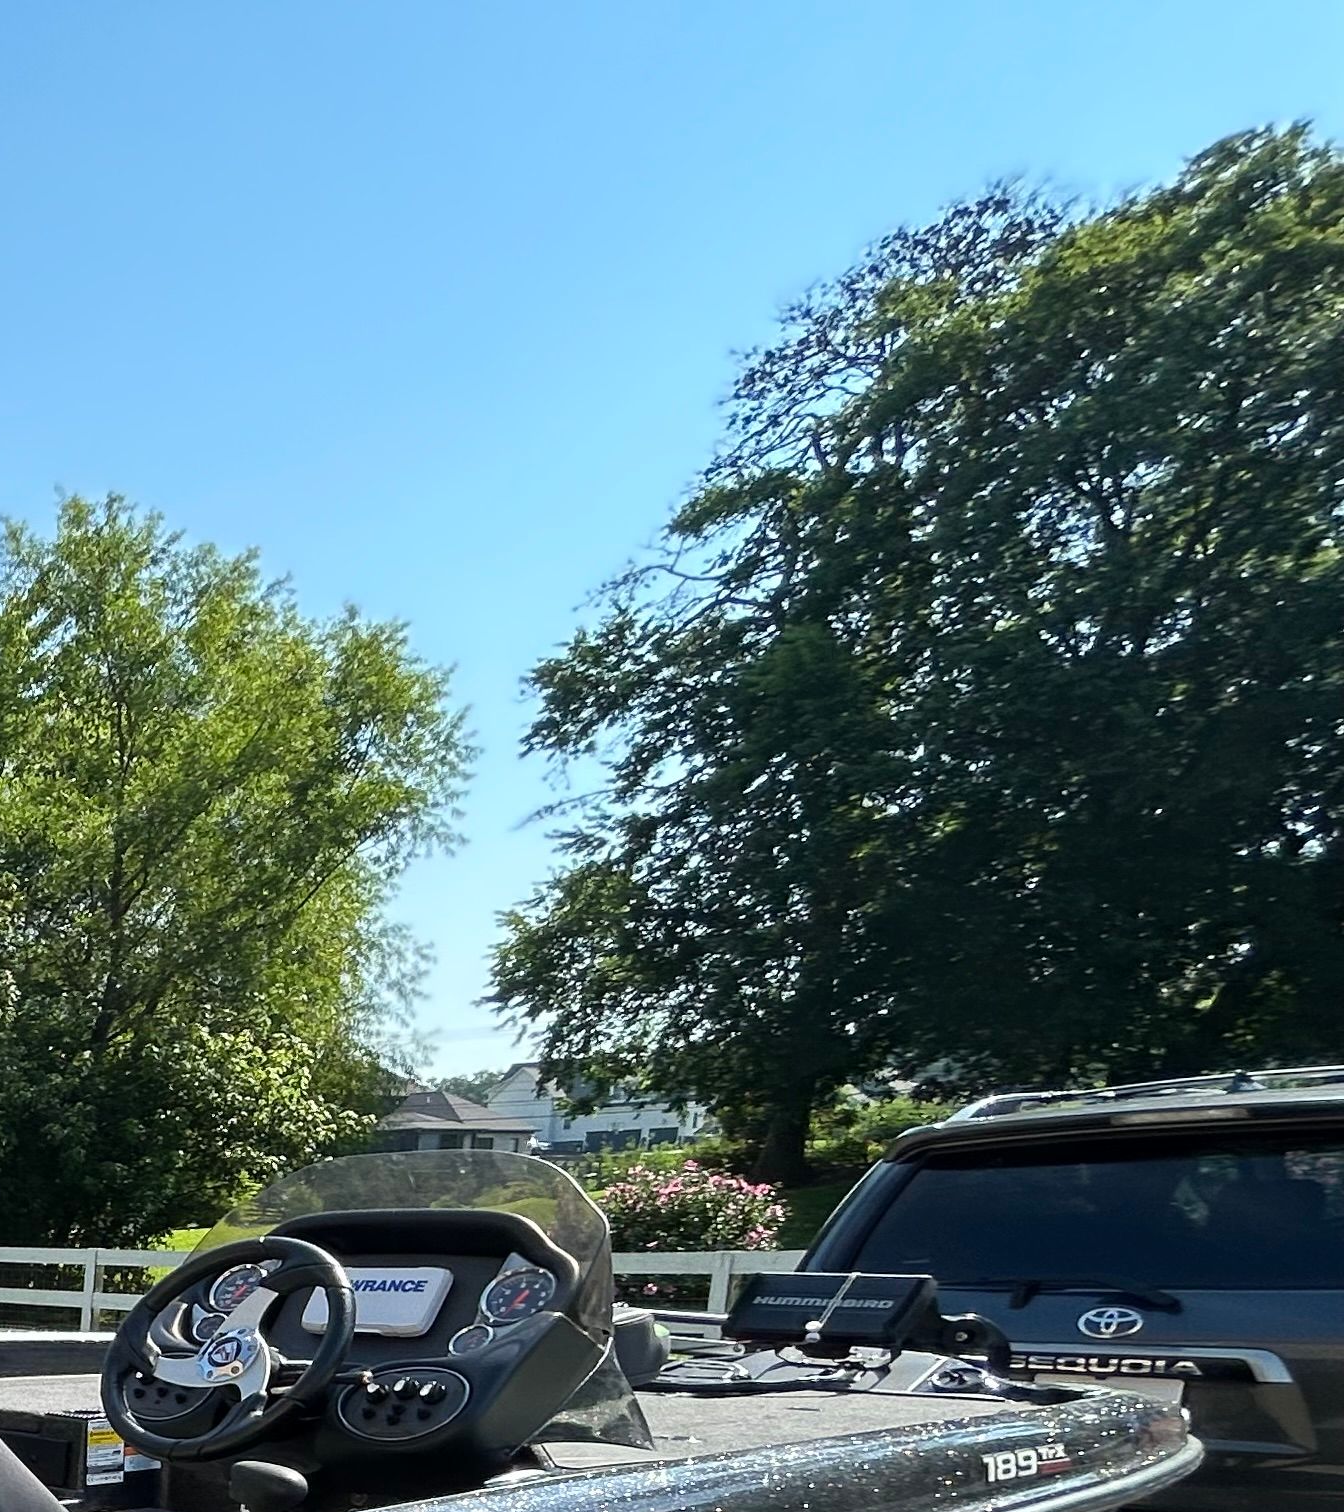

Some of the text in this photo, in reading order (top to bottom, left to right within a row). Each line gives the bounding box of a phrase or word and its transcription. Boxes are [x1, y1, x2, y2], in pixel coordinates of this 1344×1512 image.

[350, 1279, 429, 1293] WRANCE
[1009, 1354, 1203, 1376] SEQUOIA
[981, 1447, 1038, 1482] 189
